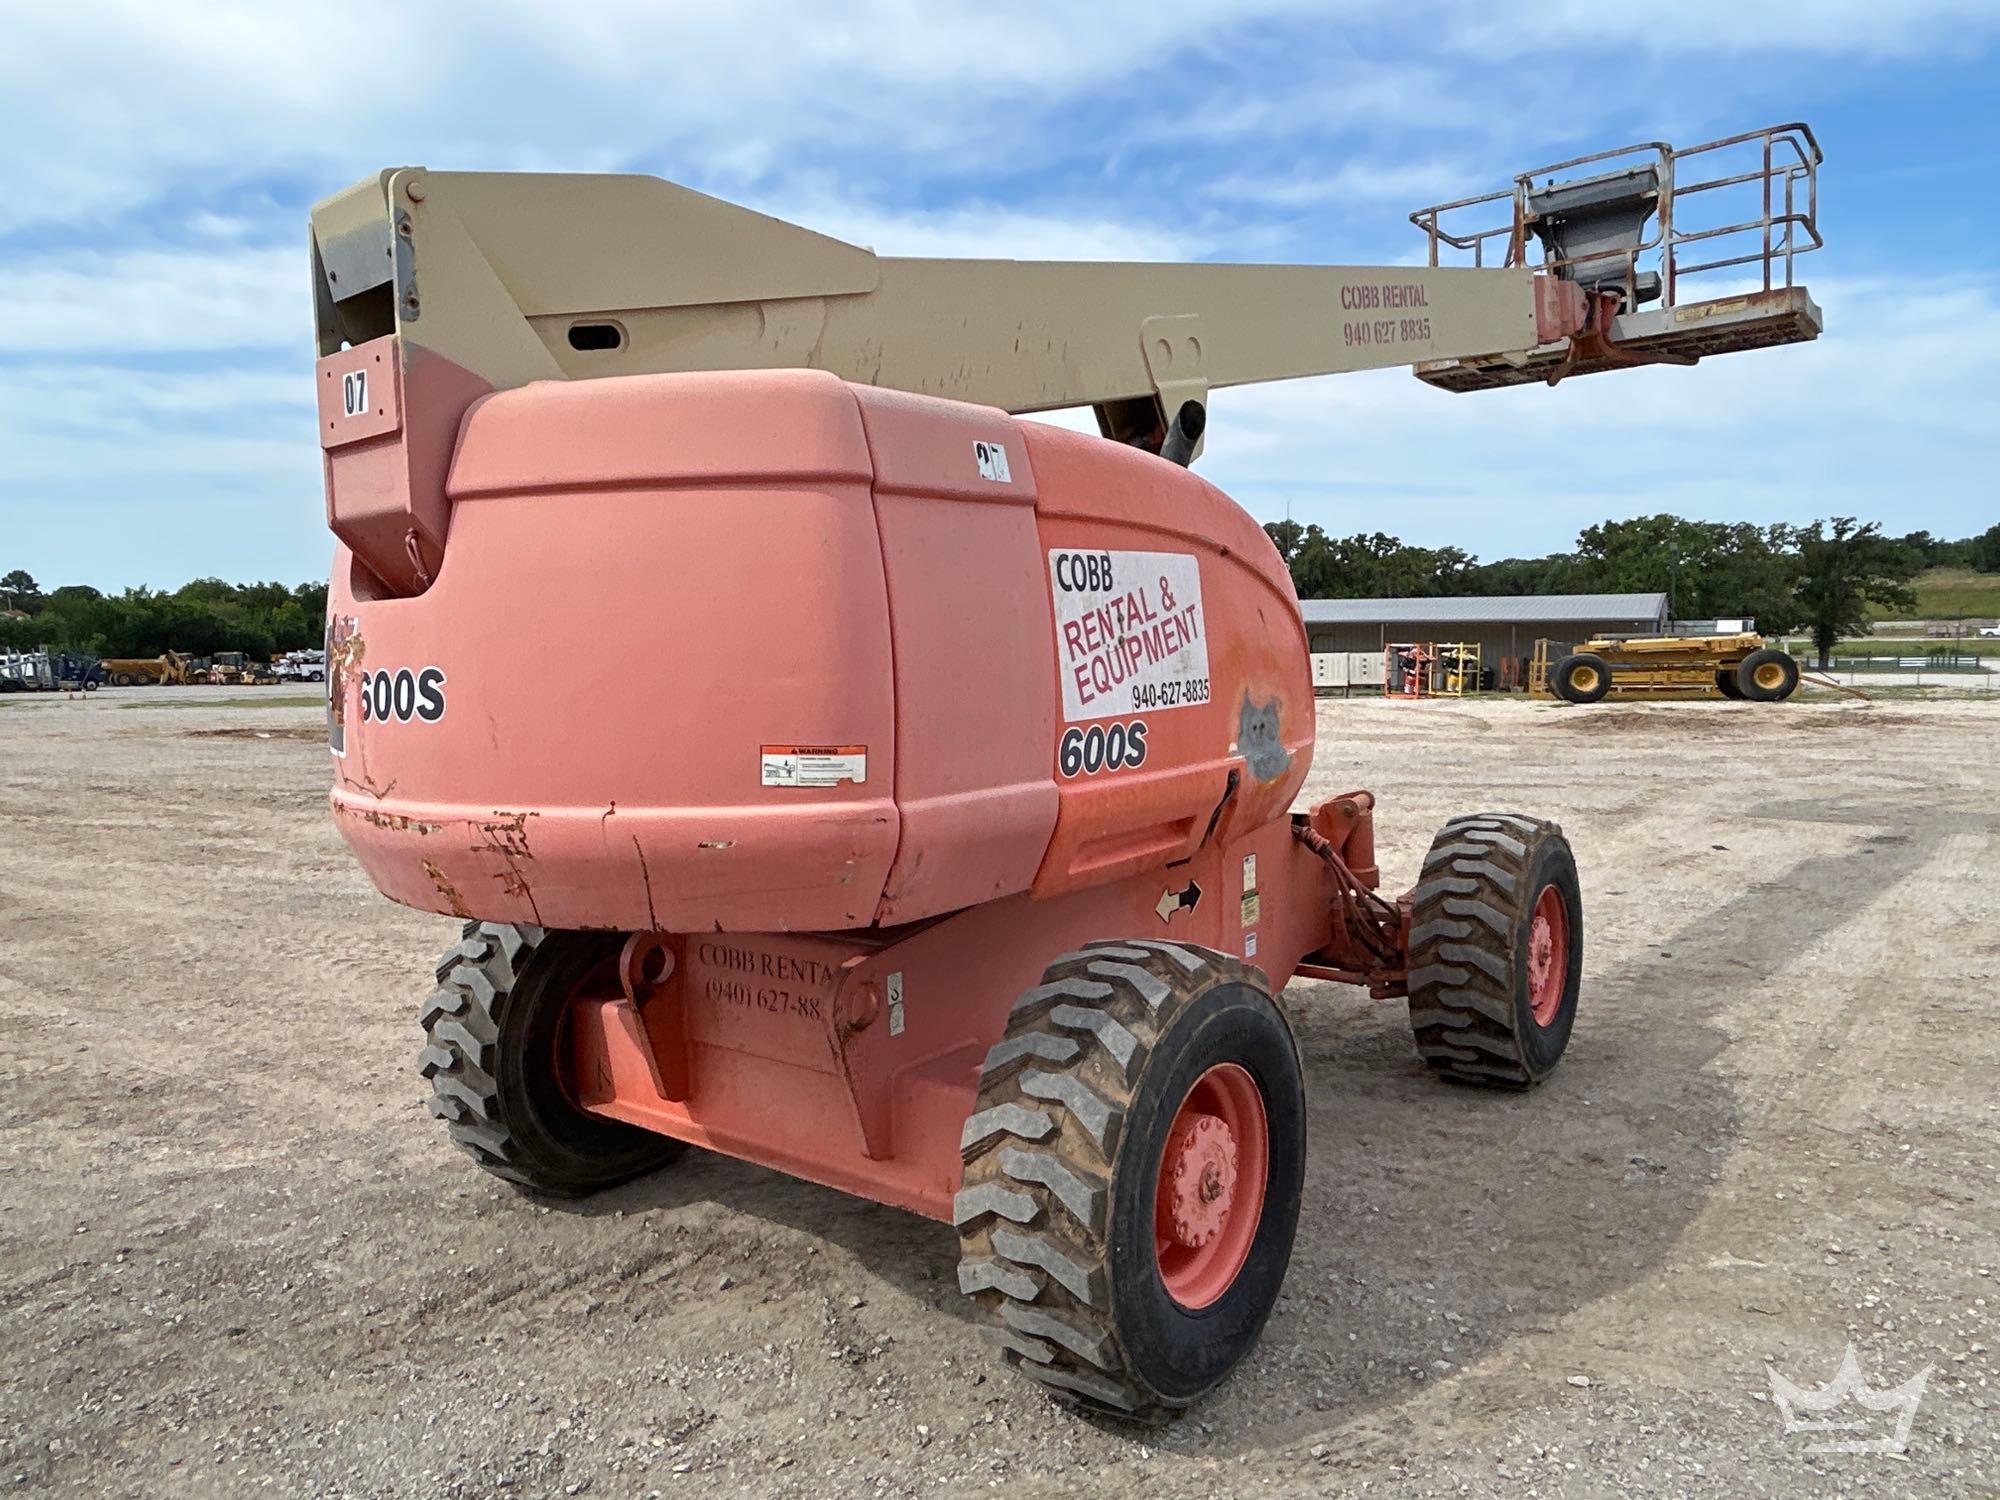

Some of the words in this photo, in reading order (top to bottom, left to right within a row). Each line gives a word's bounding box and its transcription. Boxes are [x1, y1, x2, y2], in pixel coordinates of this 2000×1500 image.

[1341, 285, 1380, 310] COBB
[1383, 284, 1429, 309] RENTAL
[1343, 321, 1370, 346] 940
[1374, 320, 1396, 344] 627
[1400, 318, 1431, 342] 8835
[345, 371, 366, 415] 07
[1056, 553, 1114, 592] COBB
[1063, 587, 1157, 662] RENTAL
[1159, 575, 1176, 612] &
[1073, 604, 1199, 705] EQUIPMENT
[1132, 678, 1210, 710] 940-627-8835
[1059, 720, 1148, 778] 600S
[699, 943, 755, 973] COBB
[761, 953, 833, 986] RENTA
[706, 978, 752, 1008] (940)
[757, 988, 821, 1020] 627-88
